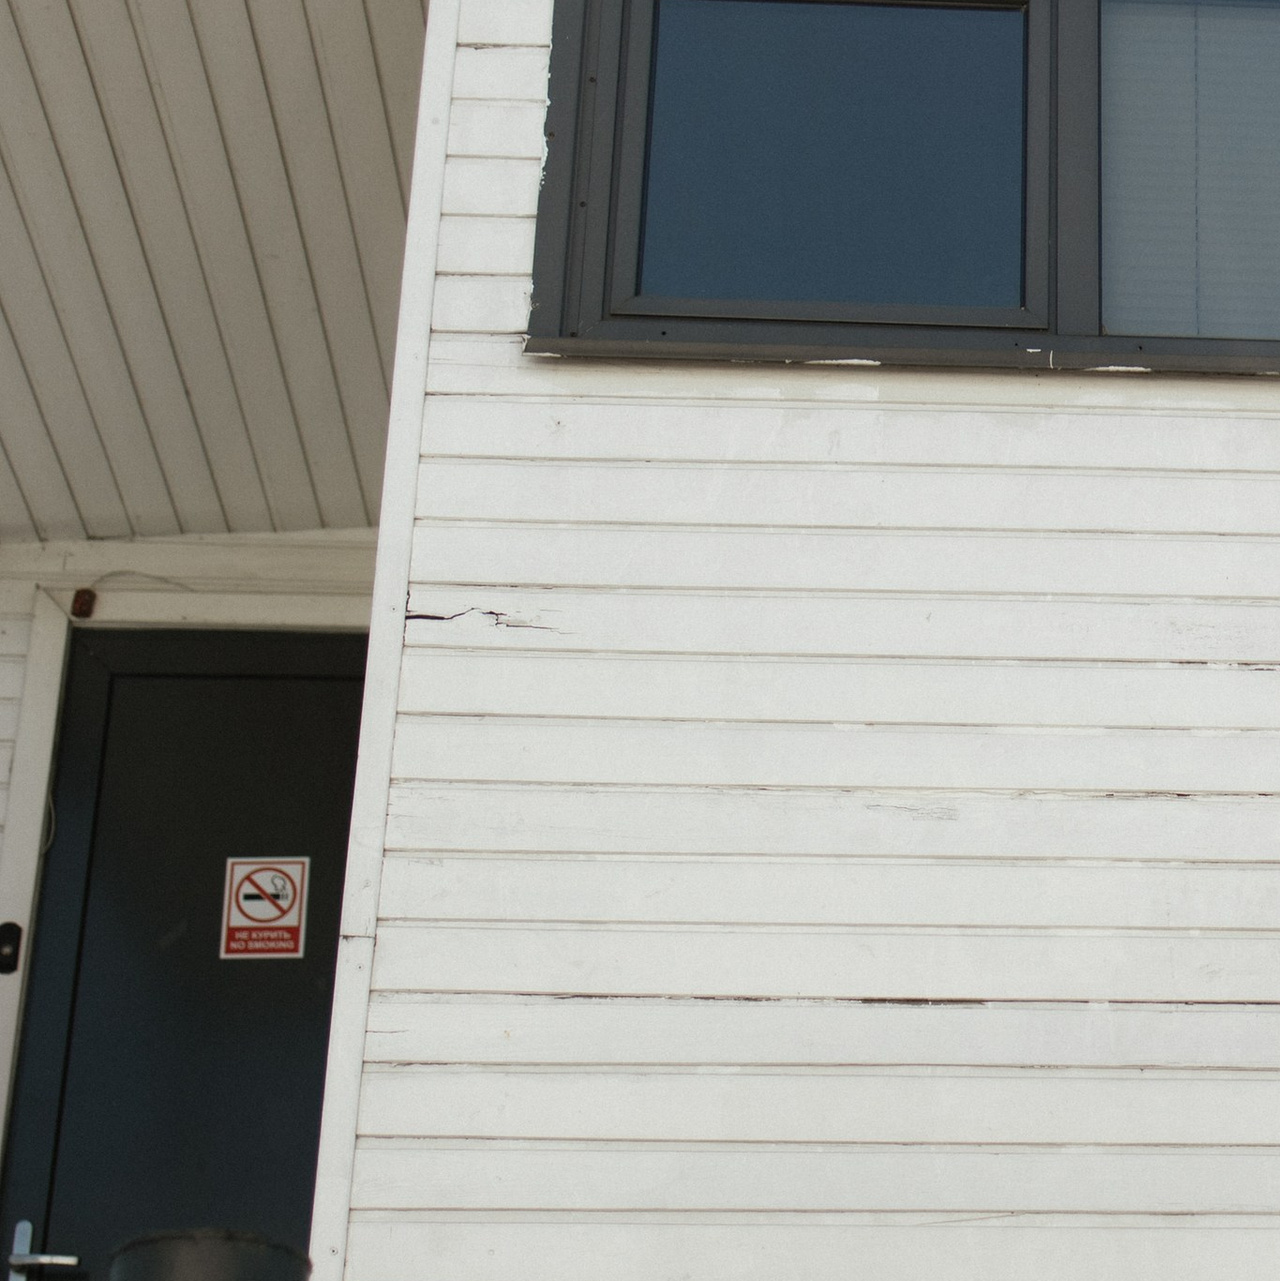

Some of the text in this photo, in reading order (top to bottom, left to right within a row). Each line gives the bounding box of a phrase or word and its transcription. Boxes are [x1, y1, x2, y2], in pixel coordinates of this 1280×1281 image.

[234, 931, 291, 940] НЕ КУРИТЬ
[230, 940, 294, 950] NO SMOKING
